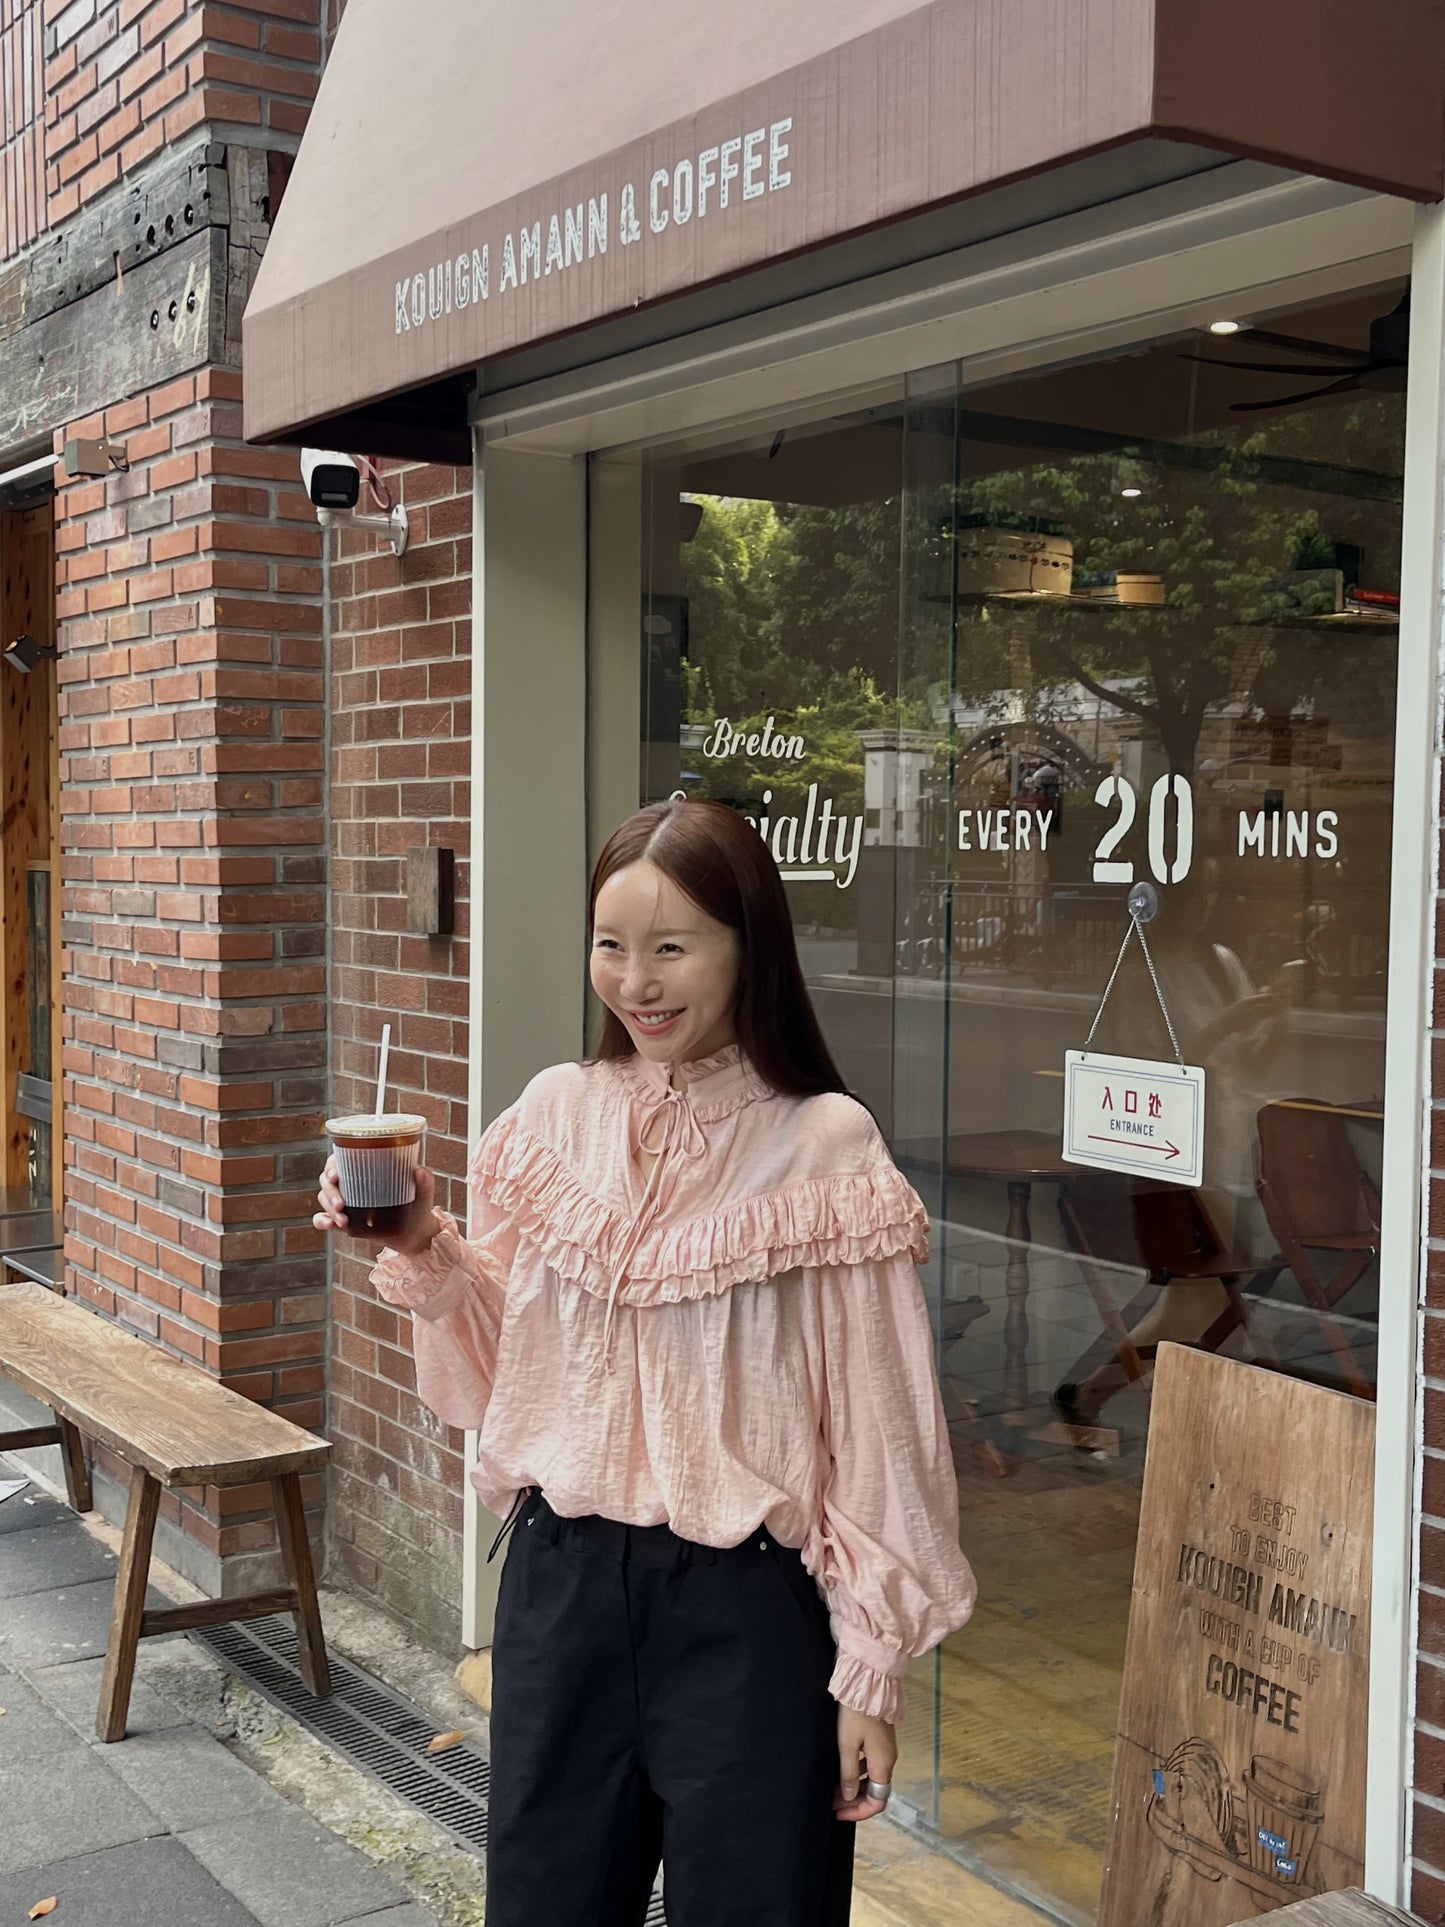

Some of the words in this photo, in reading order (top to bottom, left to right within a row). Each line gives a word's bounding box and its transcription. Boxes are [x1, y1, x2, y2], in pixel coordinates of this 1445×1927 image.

[395, 244, 489, 334] KOUIGN
[499, 192, 608, 293] AMANN
[620, 183, 641, 245] &
[650, 117, 793, 234] COFFEE
[703, 716, 806, 759] Breton
[958, 809, 1053, 851] EVERY
[1093, 773, 1193, 885] 20
[1238, 810, 1339, 859] MINS
[1110, 1119, 1155, 1137] ENTRANCE
[1249, 1493, 1297, 1536] BEST
[1177, 1543, 1264, 1615] KOUIGN
[1230, 1524, 1250, 1557] TO
[1255, 1535, 1309, 1581] ENJOY
[1200, 1609, 1241, 1651] WITH
[1243, 1629, 1256, 1659] A
[1259, 1635, 1293, 1672] CUP
[1297, 1653, 1321, 1686] OF
[1206, 1653, 1302, 1735] COFFEE
